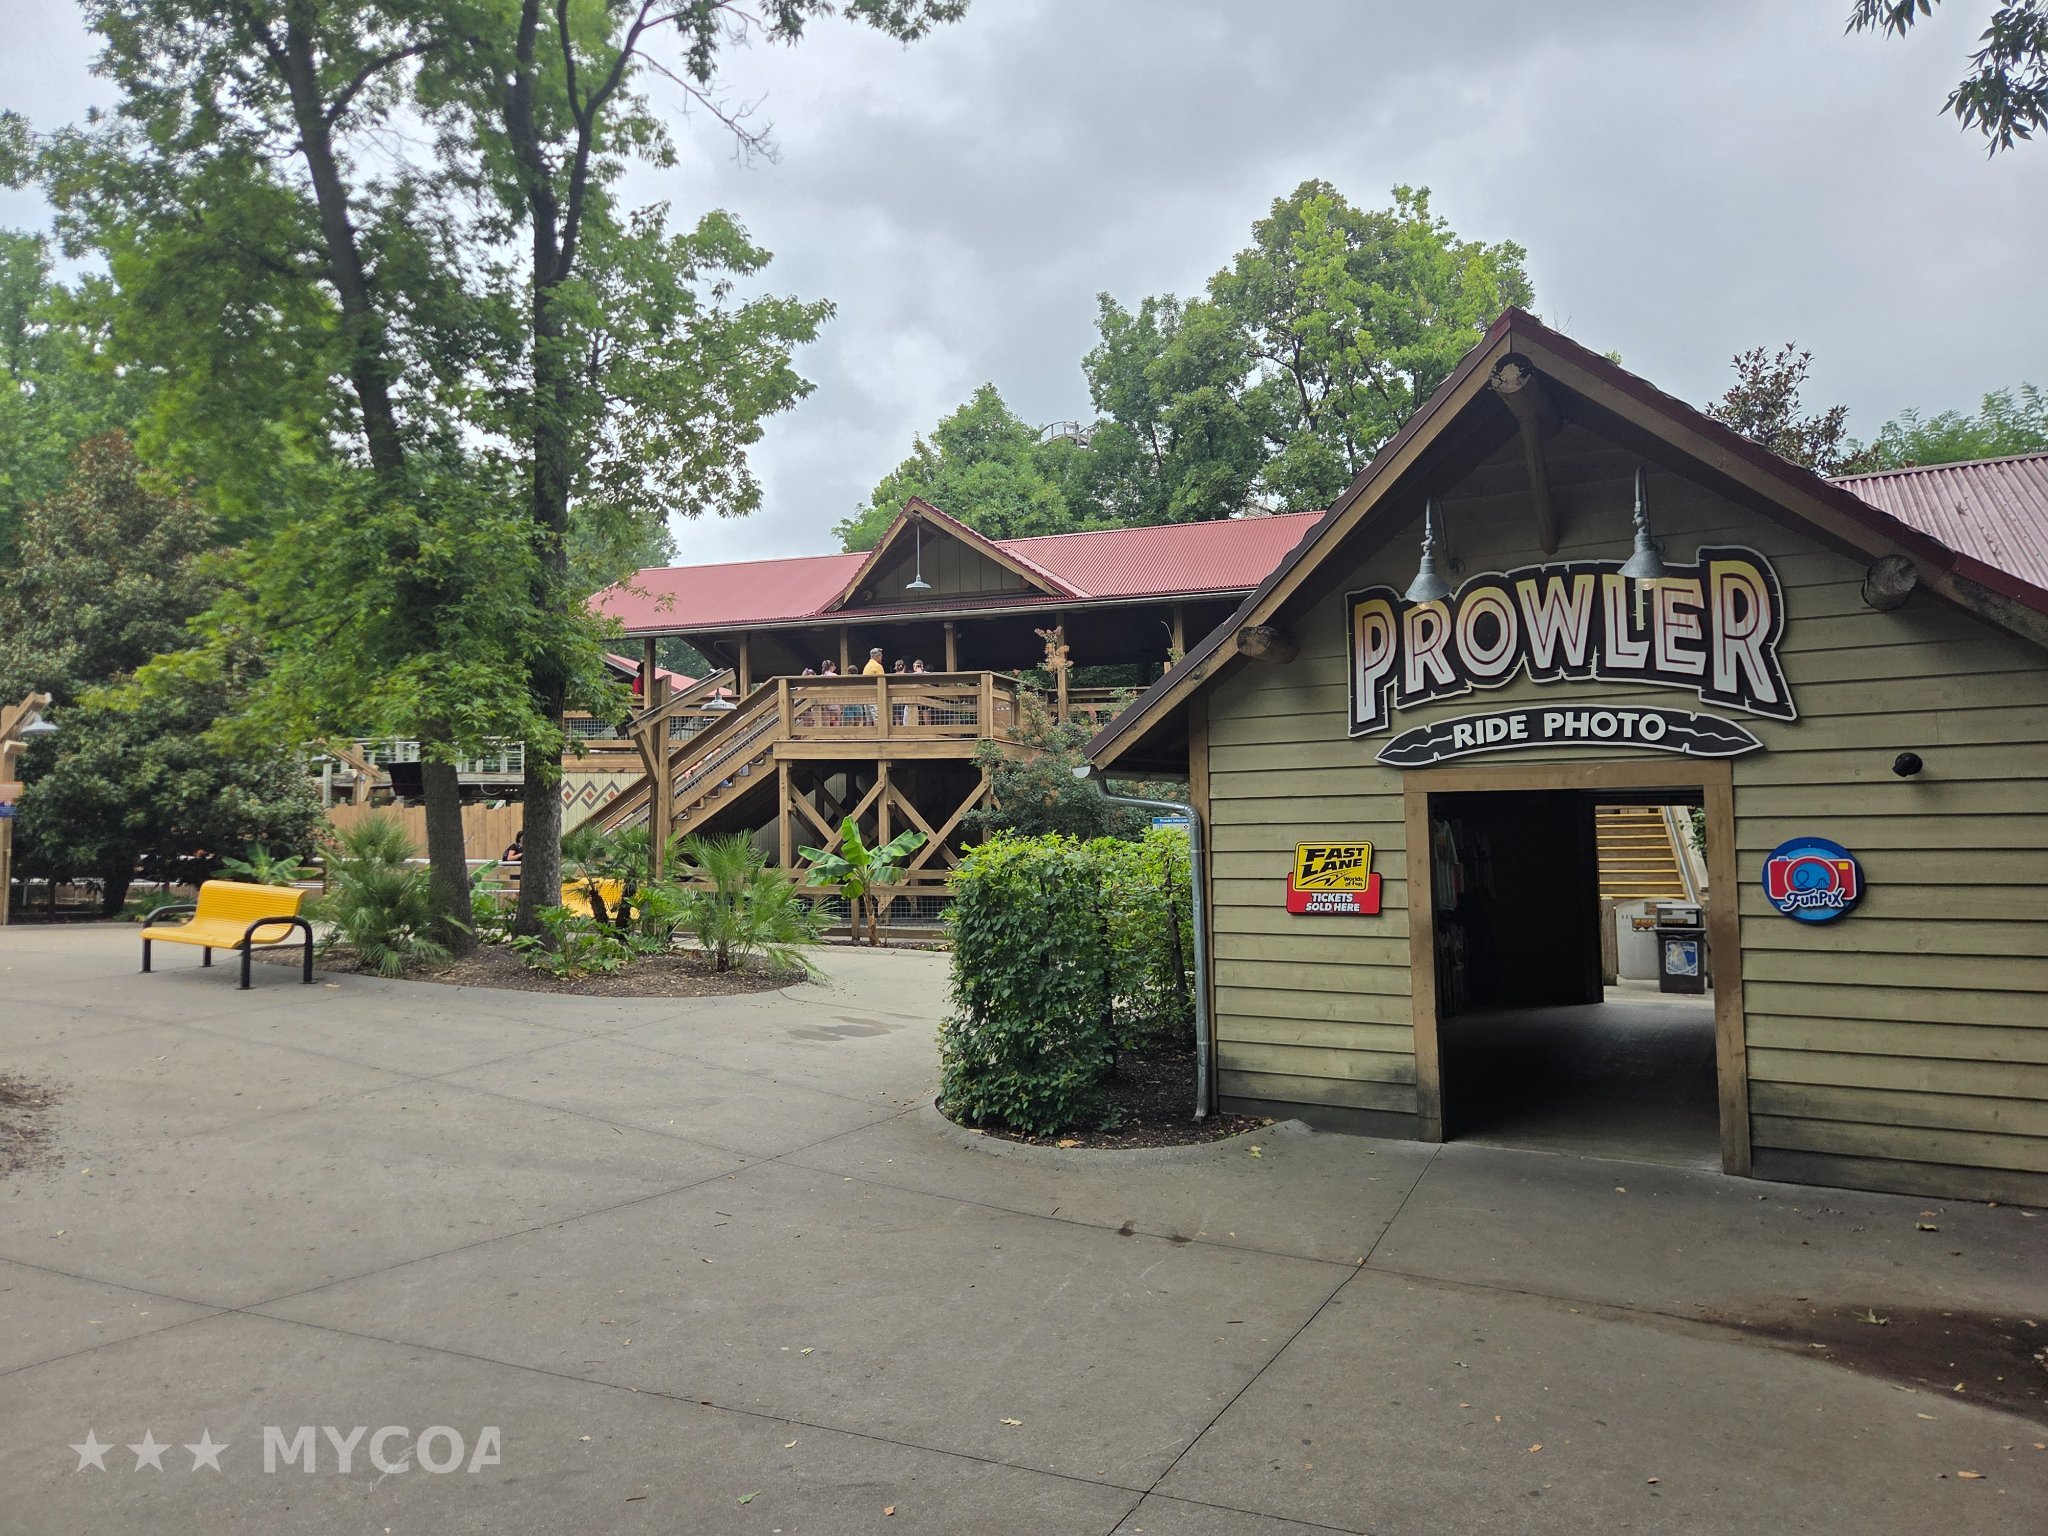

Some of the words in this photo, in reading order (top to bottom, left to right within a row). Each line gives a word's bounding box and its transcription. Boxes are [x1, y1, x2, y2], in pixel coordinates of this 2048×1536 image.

[1354, 560, 1777, 724] PROWLER
[1453, 714, 1528, 749] RIDE
[1544, 712, 1667, 740] PHOTO
[1302, 848, 1364, 862] FAST
[1300, 858, 1362, 879] LANE
[1312, 893, 1353, 902] TICKETS
[1306, 902, 1332, 911] SOLD
[1334, 903, 1360, 911] HERE
